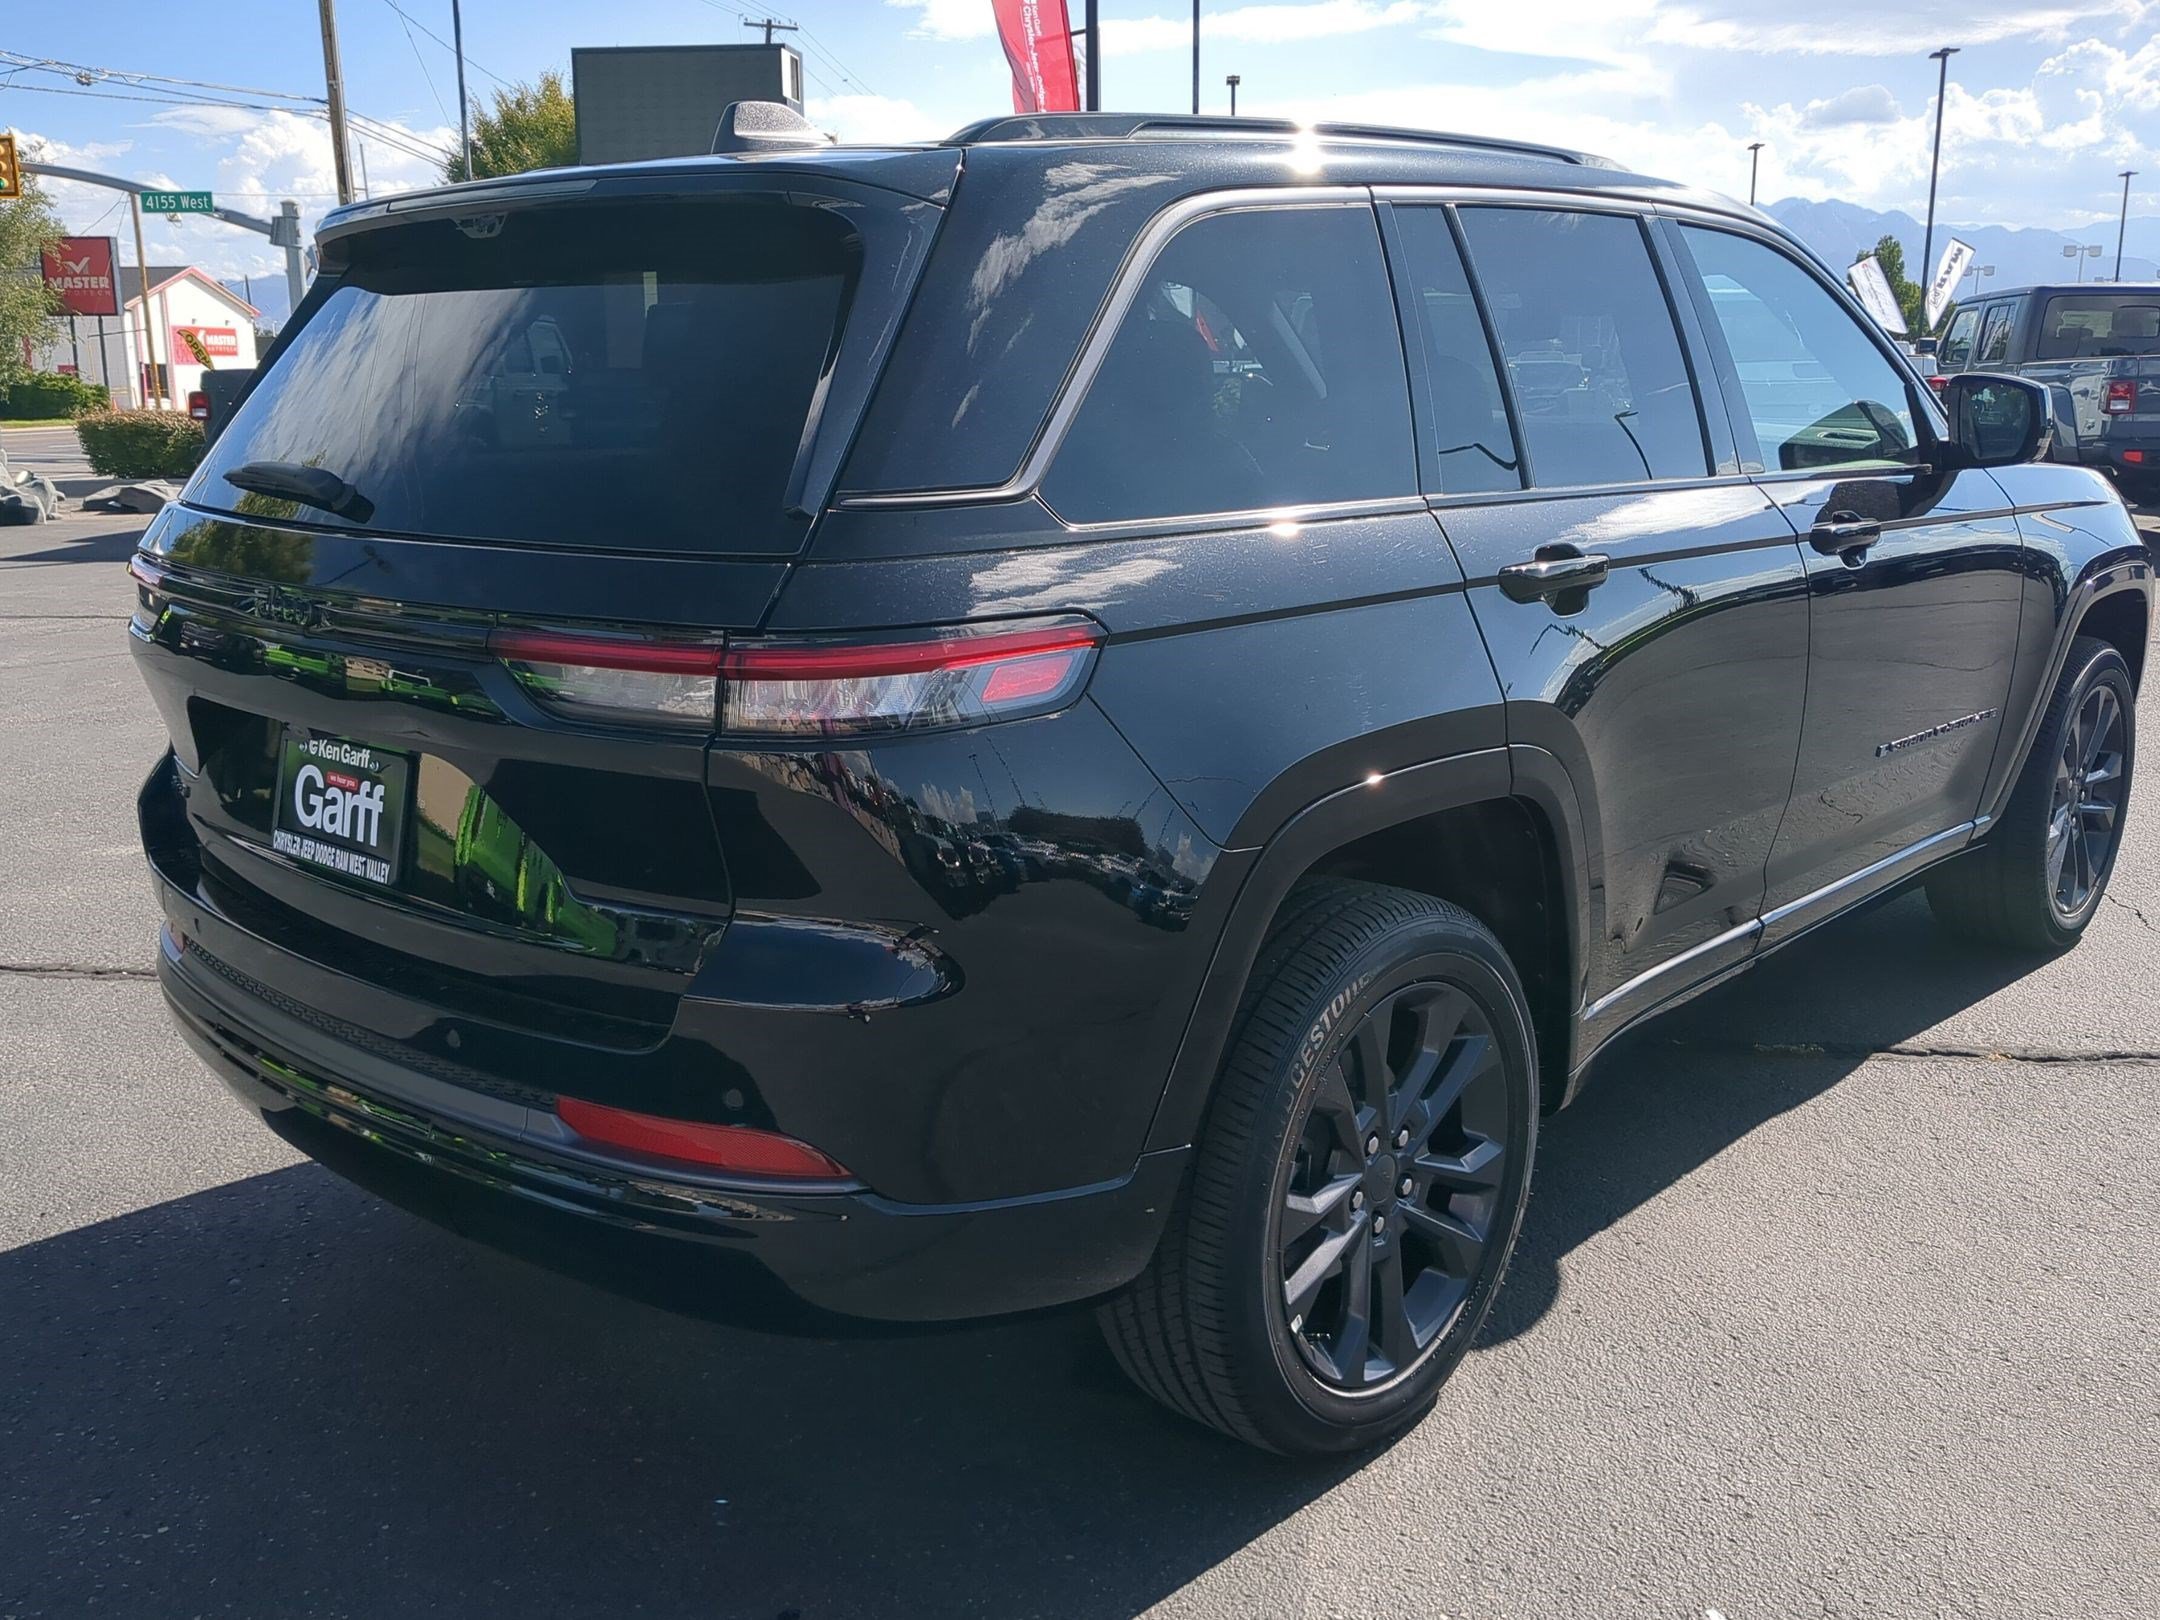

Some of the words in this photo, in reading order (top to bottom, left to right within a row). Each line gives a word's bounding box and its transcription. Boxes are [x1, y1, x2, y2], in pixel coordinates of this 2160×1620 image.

[145, 196, 176, 209] 4155
[181, 194, 209, 209] West
[49, 276, 110, 289] MASTER
[185, 334, 210, 363] OPEN
[206, 334, 237, 346] MASTER
[318, 739, 340, 762] Ken
[340, 744, 370, 769] Garff
[294, 764, 385, 847] Garff
[273, 829, 301, 856] CHRYSLER
[300, 838, 315, 860] JEEP
[315, 843, 336, 868] DODGE
[335, 848, 349, 872] RAM
[348, 853, 366, 877] WEST
[366, 858, 390, 885] VALLEY
